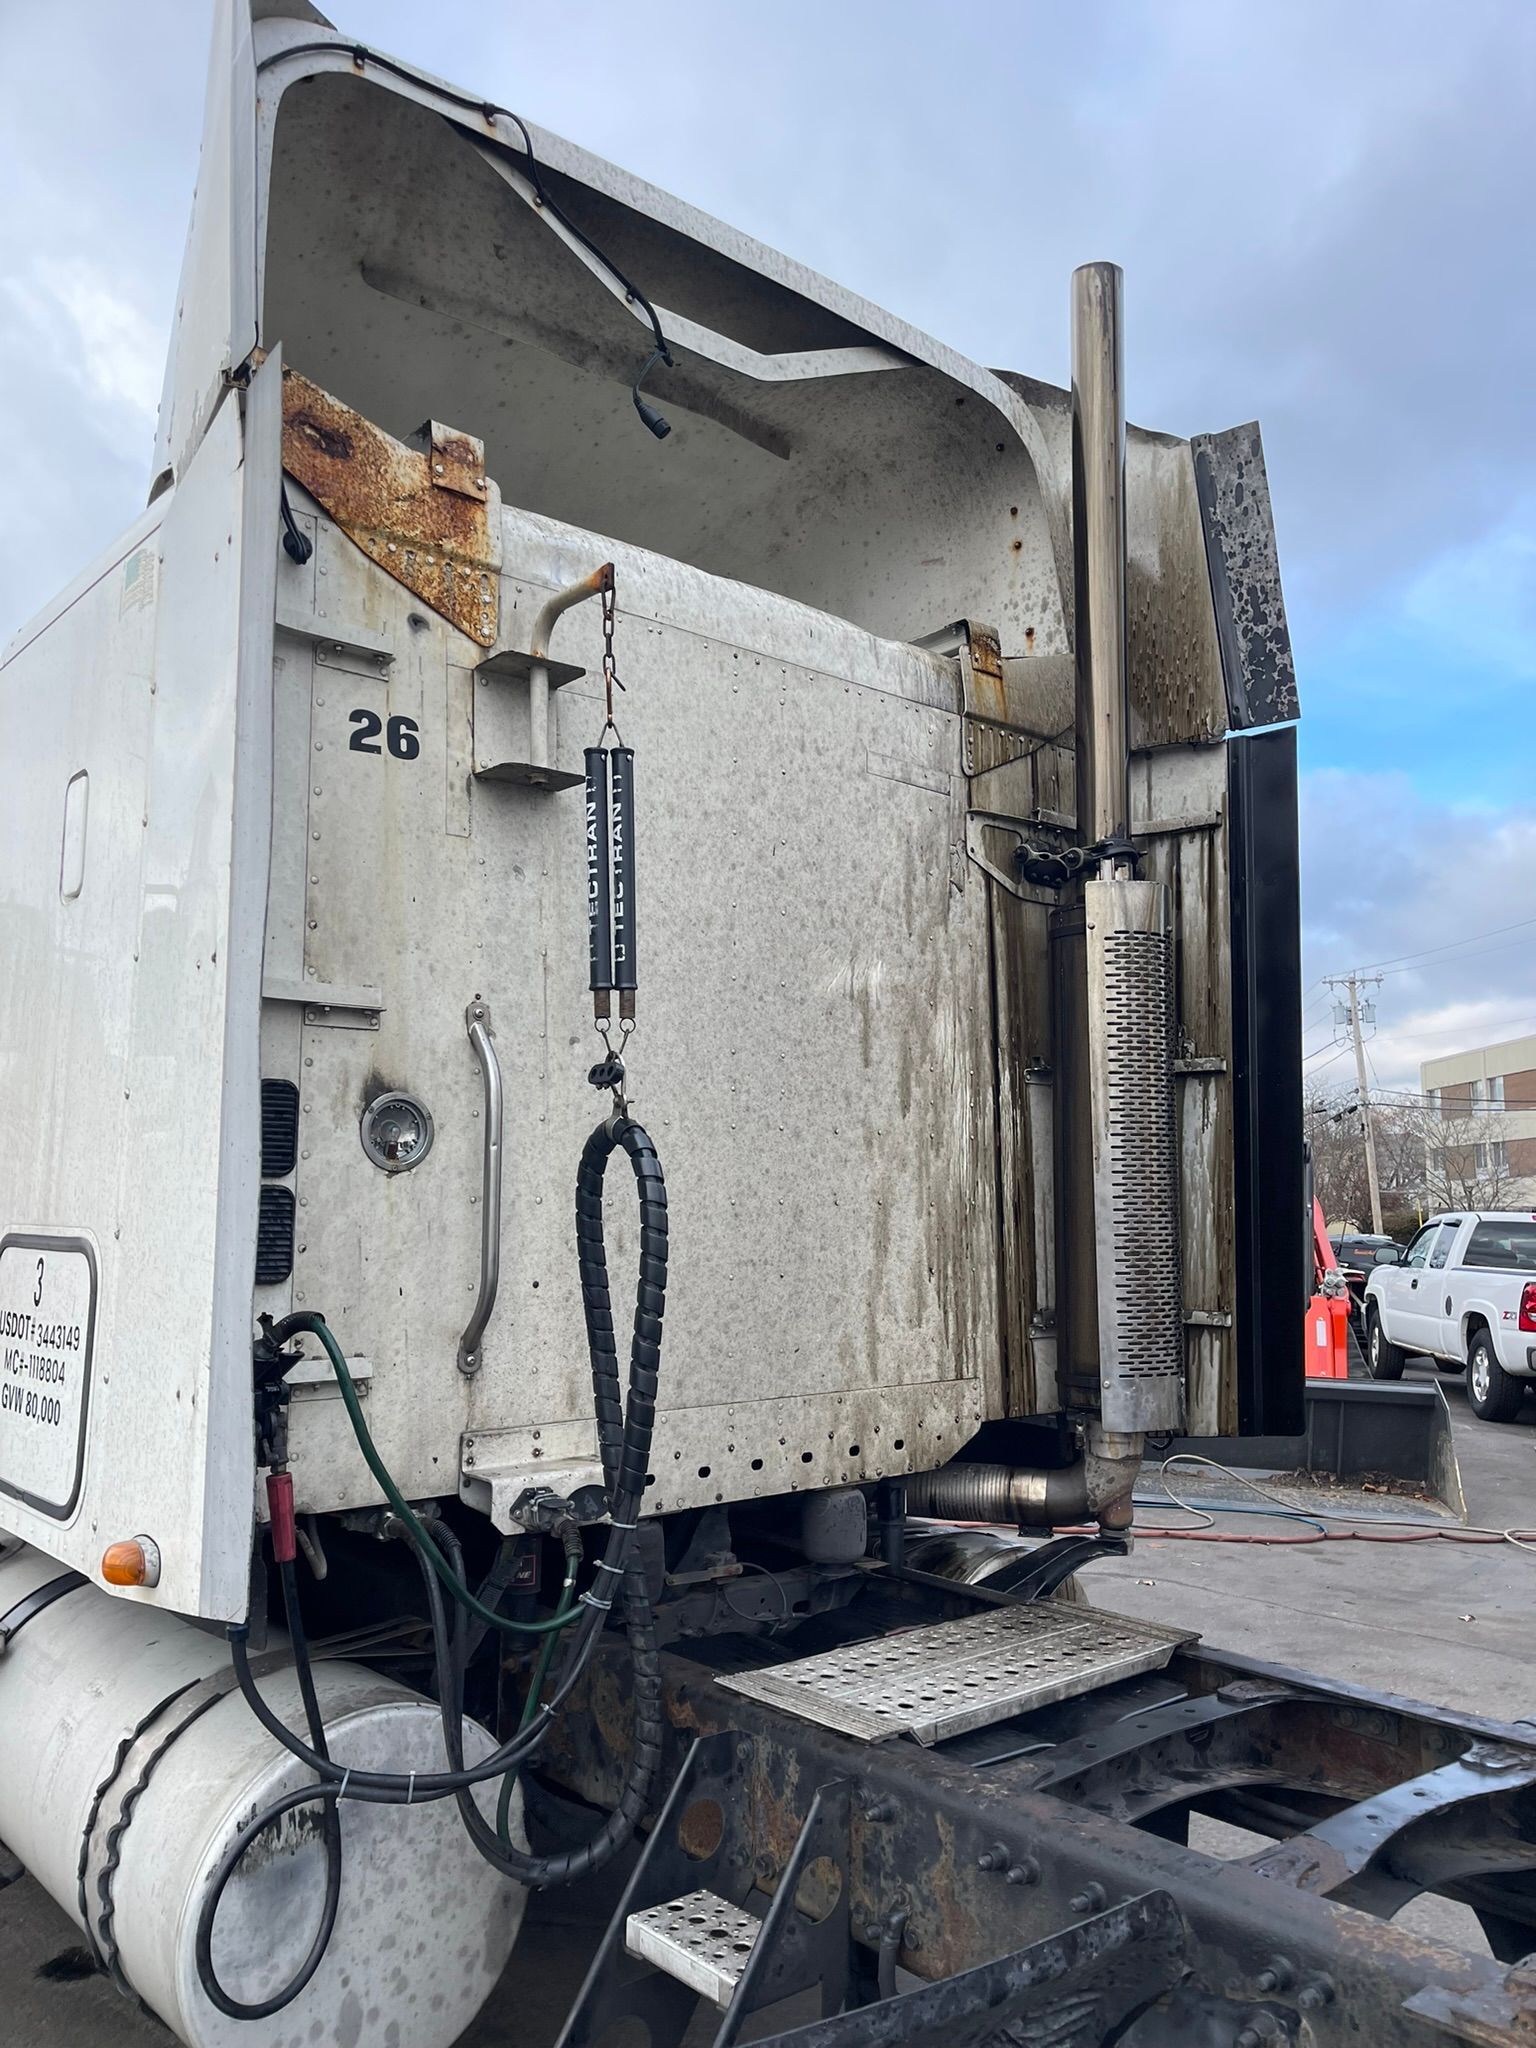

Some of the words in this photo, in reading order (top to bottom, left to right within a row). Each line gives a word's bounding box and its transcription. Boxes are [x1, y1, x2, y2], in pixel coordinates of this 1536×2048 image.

[348, 709, 420, 760] 26
[34, 1257, 44, 1307] 3
[2, 1383, 24, 1414] GVW
[26, 1391, 61, 1426] 80,000
